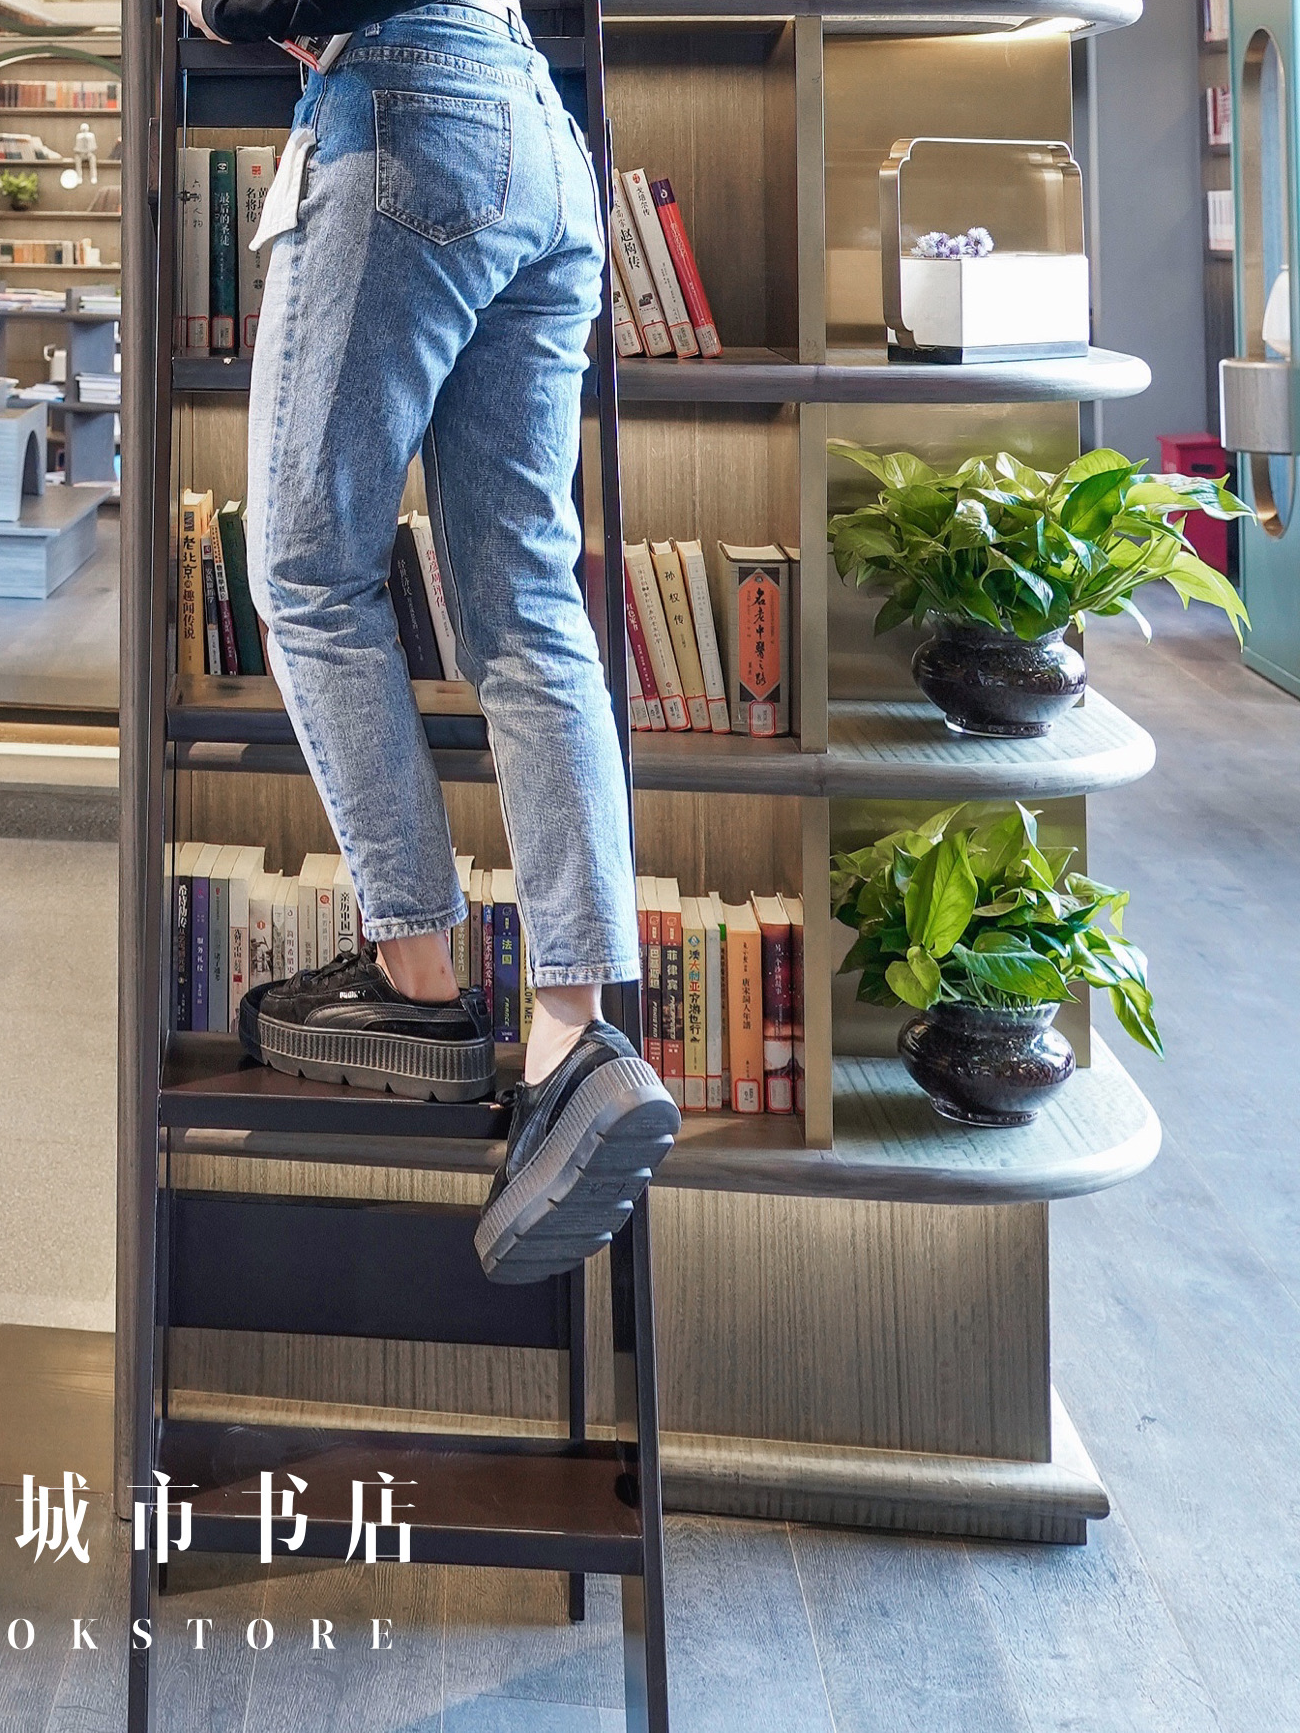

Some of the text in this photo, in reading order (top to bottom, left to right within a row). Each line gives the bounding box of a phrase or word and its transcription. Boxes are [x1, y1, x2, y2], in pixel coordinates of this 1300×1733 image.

[246, 188, 257, 224] 名将传
[619, 228, 641, 270] 赵构传
[664, 570, 684, 626] 孙权传
[753, 587, 767, 687] 名老中醫之路
[649, 948, 660, 990] 巴基斯坦
[667, 948, 678, 990] 菲律宾
[688, 949, 701, 1036] 澳大利亚穷游也行
